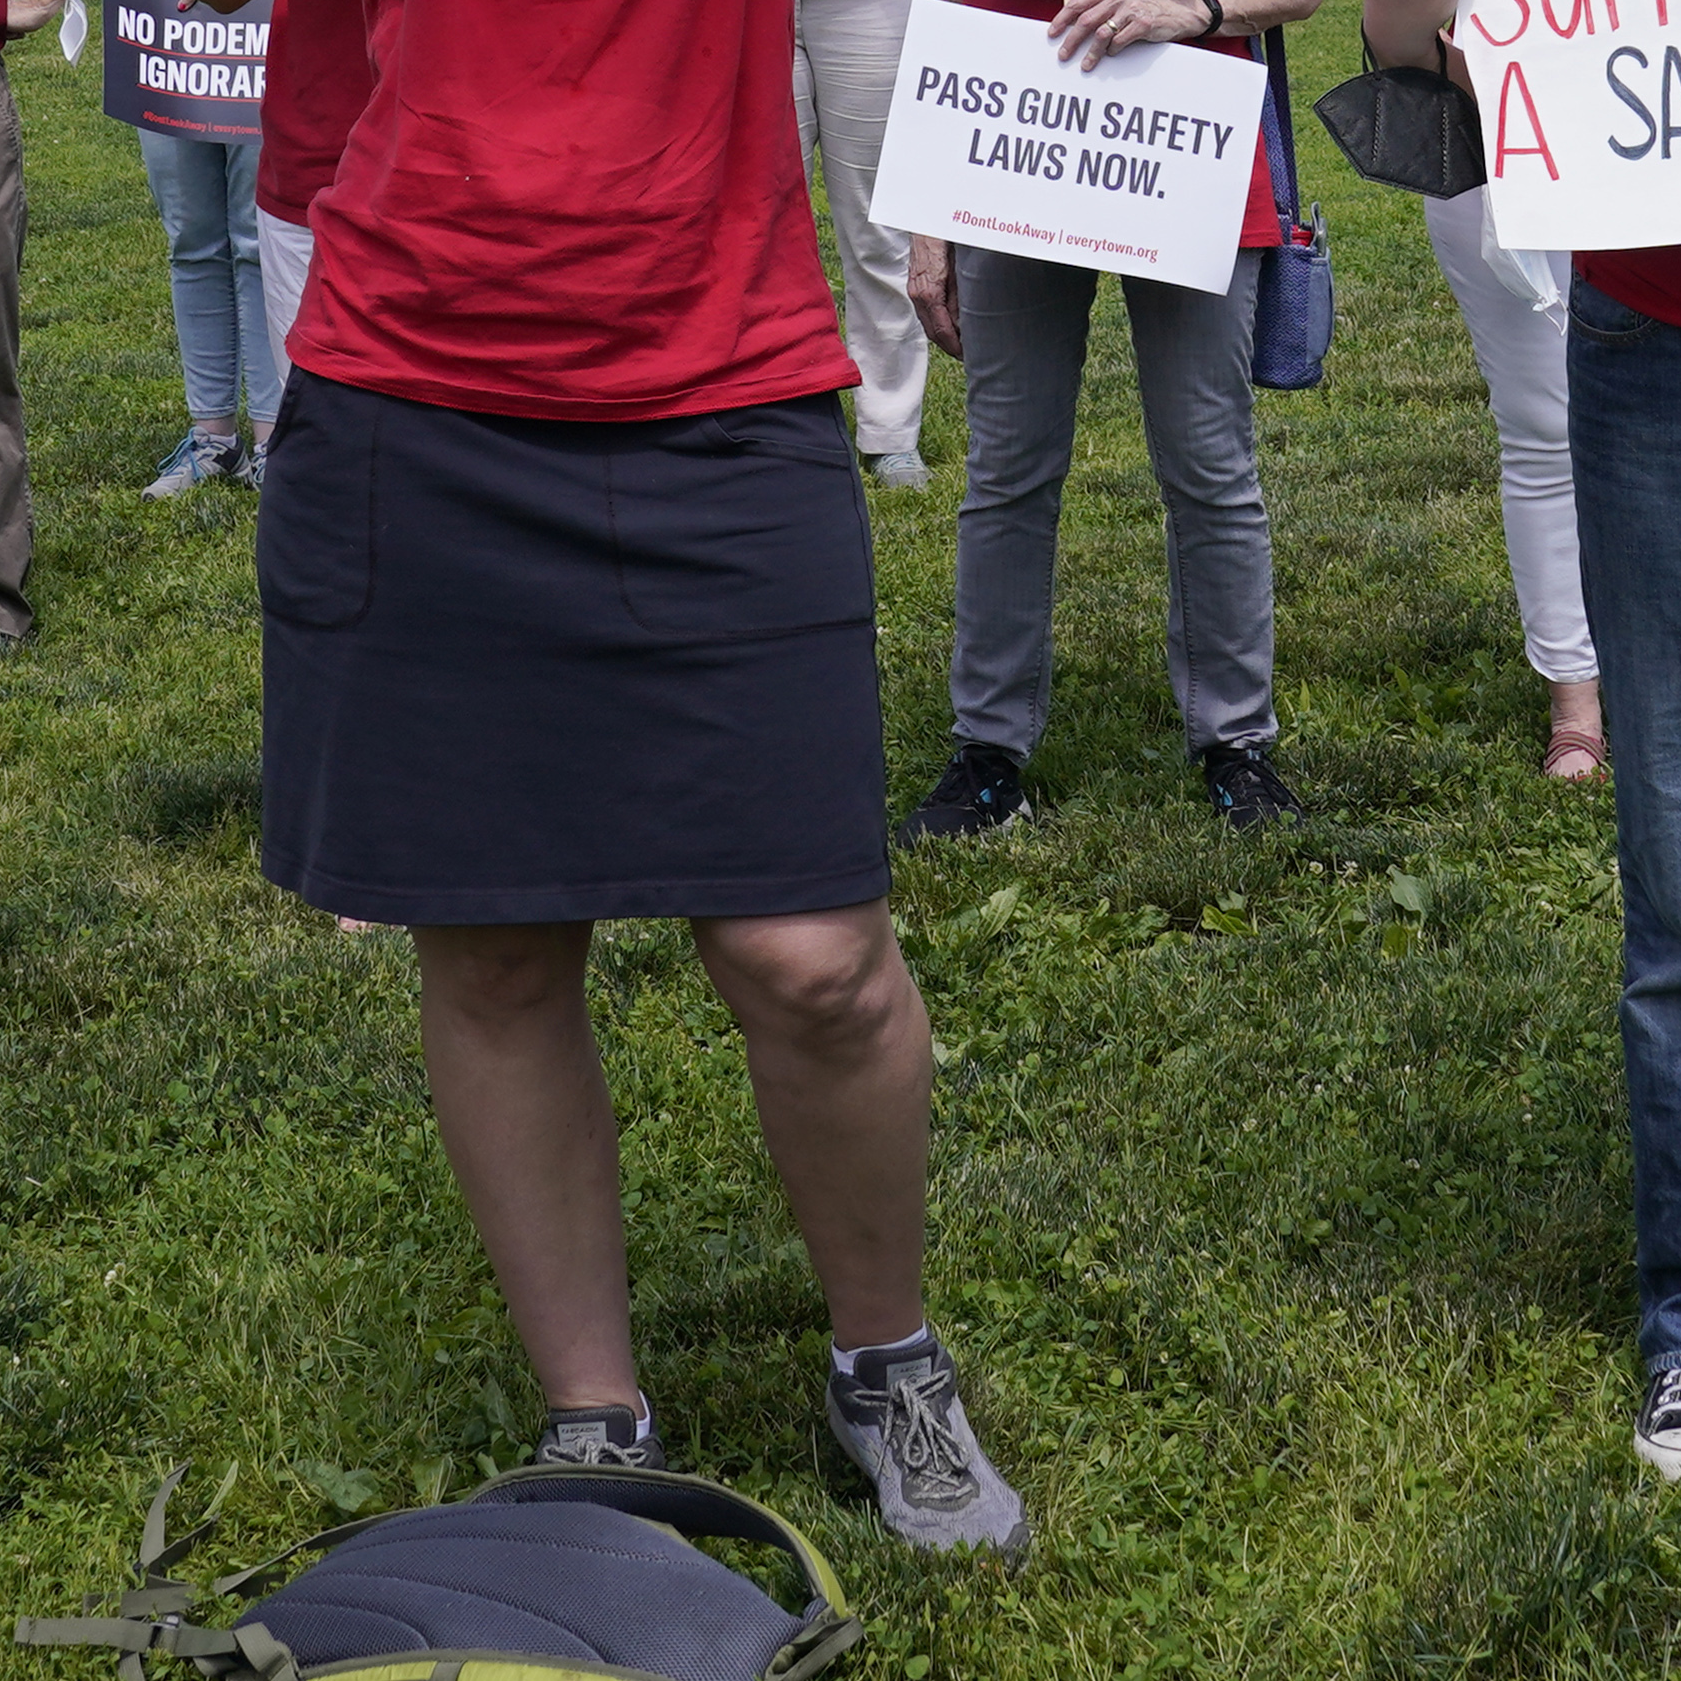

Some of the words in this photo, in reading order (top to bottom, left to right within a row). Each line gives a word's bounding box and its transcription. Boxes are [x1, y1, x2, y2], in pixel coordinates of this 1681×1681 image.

[118, 6, 155, 46] NO
[163, 18, 270, 56] PODEM
[916, 66, 1009, 116] PASS
[1016, 86, 1089, 135] GUN
[1101, 103, 1234, 161] SAFETY
[1494, 61, 1560, 181] A
[968, 128, 1069, 180] LAWS
[1076, 148, 1167, 200] NOW.
[952, 209, 1055, 245] #DontLookAway
[1066, 234, 1159, 264] everytown.org
